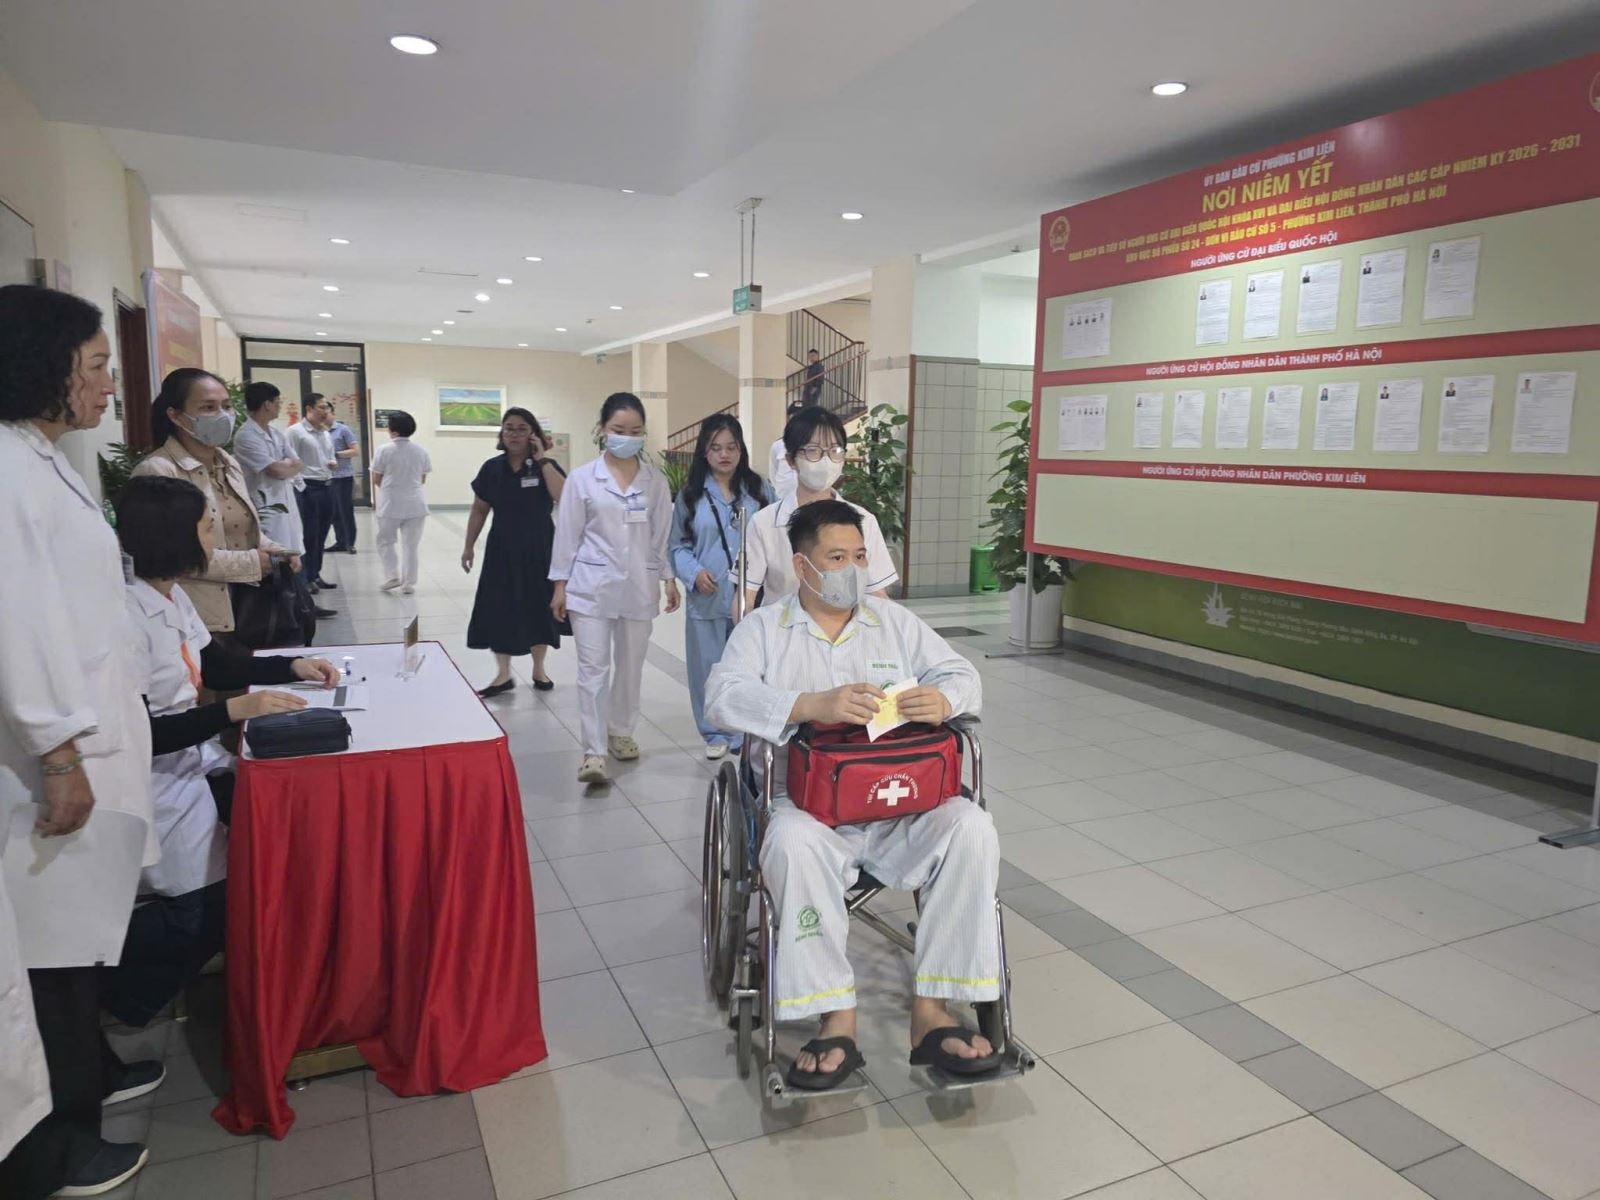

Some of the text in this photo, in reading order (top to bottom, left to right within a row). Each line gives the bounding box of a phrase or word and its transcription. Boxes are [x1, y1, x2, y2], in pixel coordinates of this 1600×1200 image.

[1262, 152, 1296, 171] PHƯỜNG
[1297, 146, 1315, 162] KIM
[1316, 140, 1336, 156] LIÊN
[1294, 194, 1314, 210] BIỂU
[1314, 191, 1330, 206] HỘI
[1331, 185, 1356, 202] ĐỒNG
[1357, 180, 1383, 196] NHÂN
[1384, 174, 1405, 190] DÂN
[1406, 168, 1428, 185] CÁC
[1430, 162, 1452, 180] CẤP
[1453, 154, 1488, 174] NHIỆM
[1508, 144, 1539, 162] 2026
[1550, 133, 1581, 152] 2031
[1202, 155, 1334, 213] NƠI NIÊM YẾT
[1258, 222, 1270, 236] SỐ
[1270, 222, 1277, 233] 5
[1282, 212, 1316, 230] PHƯỜNG
[1317, 209, 1334, 222] KIM
[1358, 196, 1389, 214] THÀNH
[1390, 191, 1411, 208] PHỐ
[1412, 187, 1426, 203] HÀ
[1428, 184, 1448, 200] NỘI
[1190, 230, 1338, 268] NGƯỜI ỨNG CỬ ĐẠI BIỂU QUỐC HỘI
[1146, 347, 1382, 376] NGƯỜI ỨNG CỬ HỘI ĐỒNG NHÂN DÂN THÀNH PHỐ HÀ NỘI
[1142, 466, 1366, 484] NGƯỜI ỨNG CỬ HỘI ĐỒNG NHÂN DÂN PHƯỜNG KIM LIÊN
